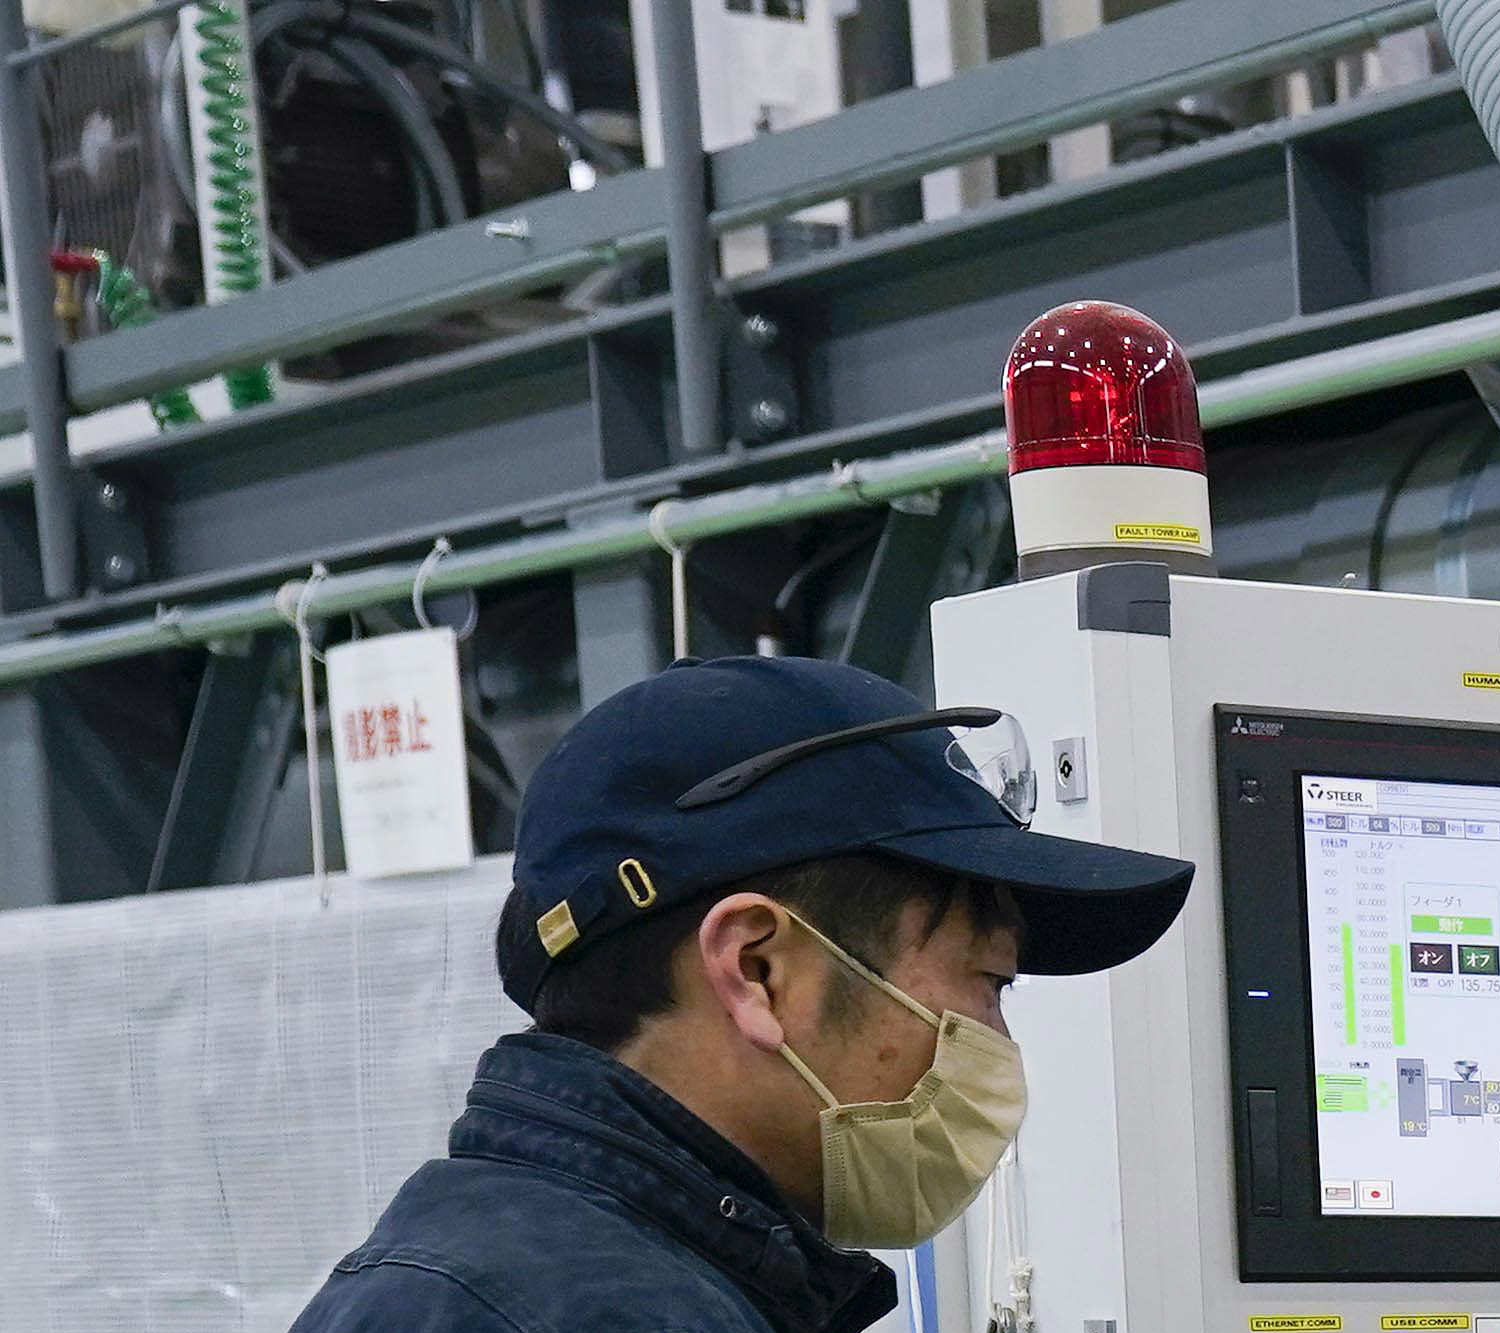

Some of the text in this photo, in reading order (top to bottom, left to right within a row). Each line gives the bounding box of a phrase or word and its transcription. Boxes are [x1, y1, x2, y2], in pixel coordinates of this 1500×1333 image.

[1120, 528, 1148, 536] FAULT
[1327, 790, 1363, 802] STEER
[1418, 951, 1443, 966] オン
[1466, 953, 1490, 967] オフ
[1255, 1319, 1336, 1328] ETHERNET COMM
[1390, 1318, 1458, 1327] USB COMM
